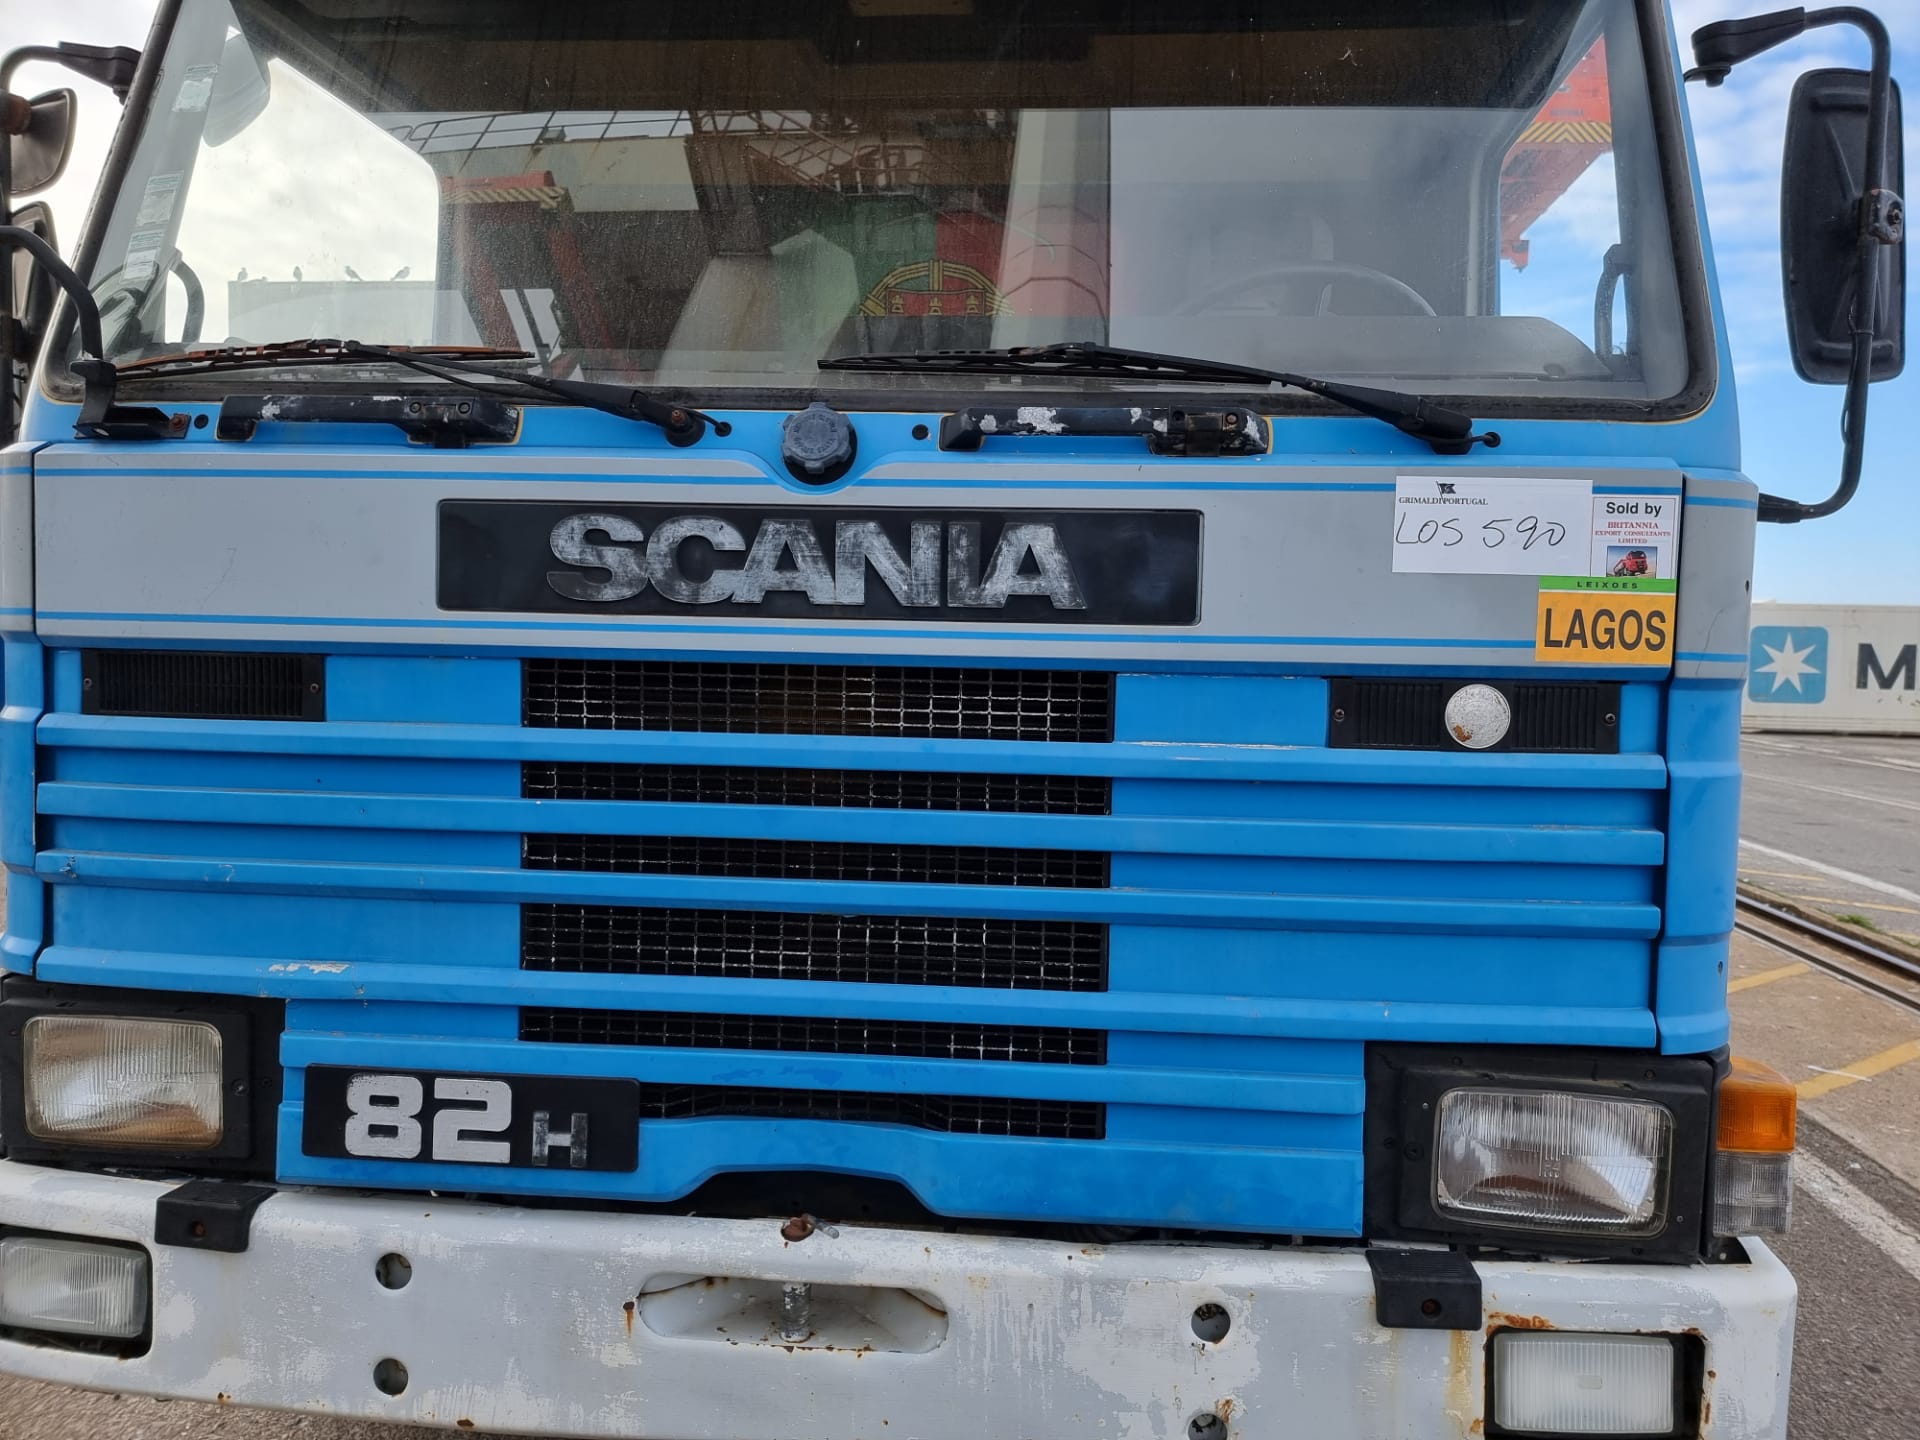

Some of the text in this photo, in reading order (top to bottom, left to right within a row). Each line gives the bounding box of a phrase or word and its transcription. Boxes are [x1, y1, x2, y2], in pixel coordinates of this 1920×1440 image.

[1606, 502, 1662, 517] Sold by
[1607, 521, 1659, 529] BRITANNIA
[1395, 512, 1463, 547] LOS
[547, 513, 1087, 610] SCANIA
[1577, 581, 1638, 589] LEIXOES
[1544, 608, 1666, 651] LAGOS
[345, 1073, 588, 1167] 82 H
